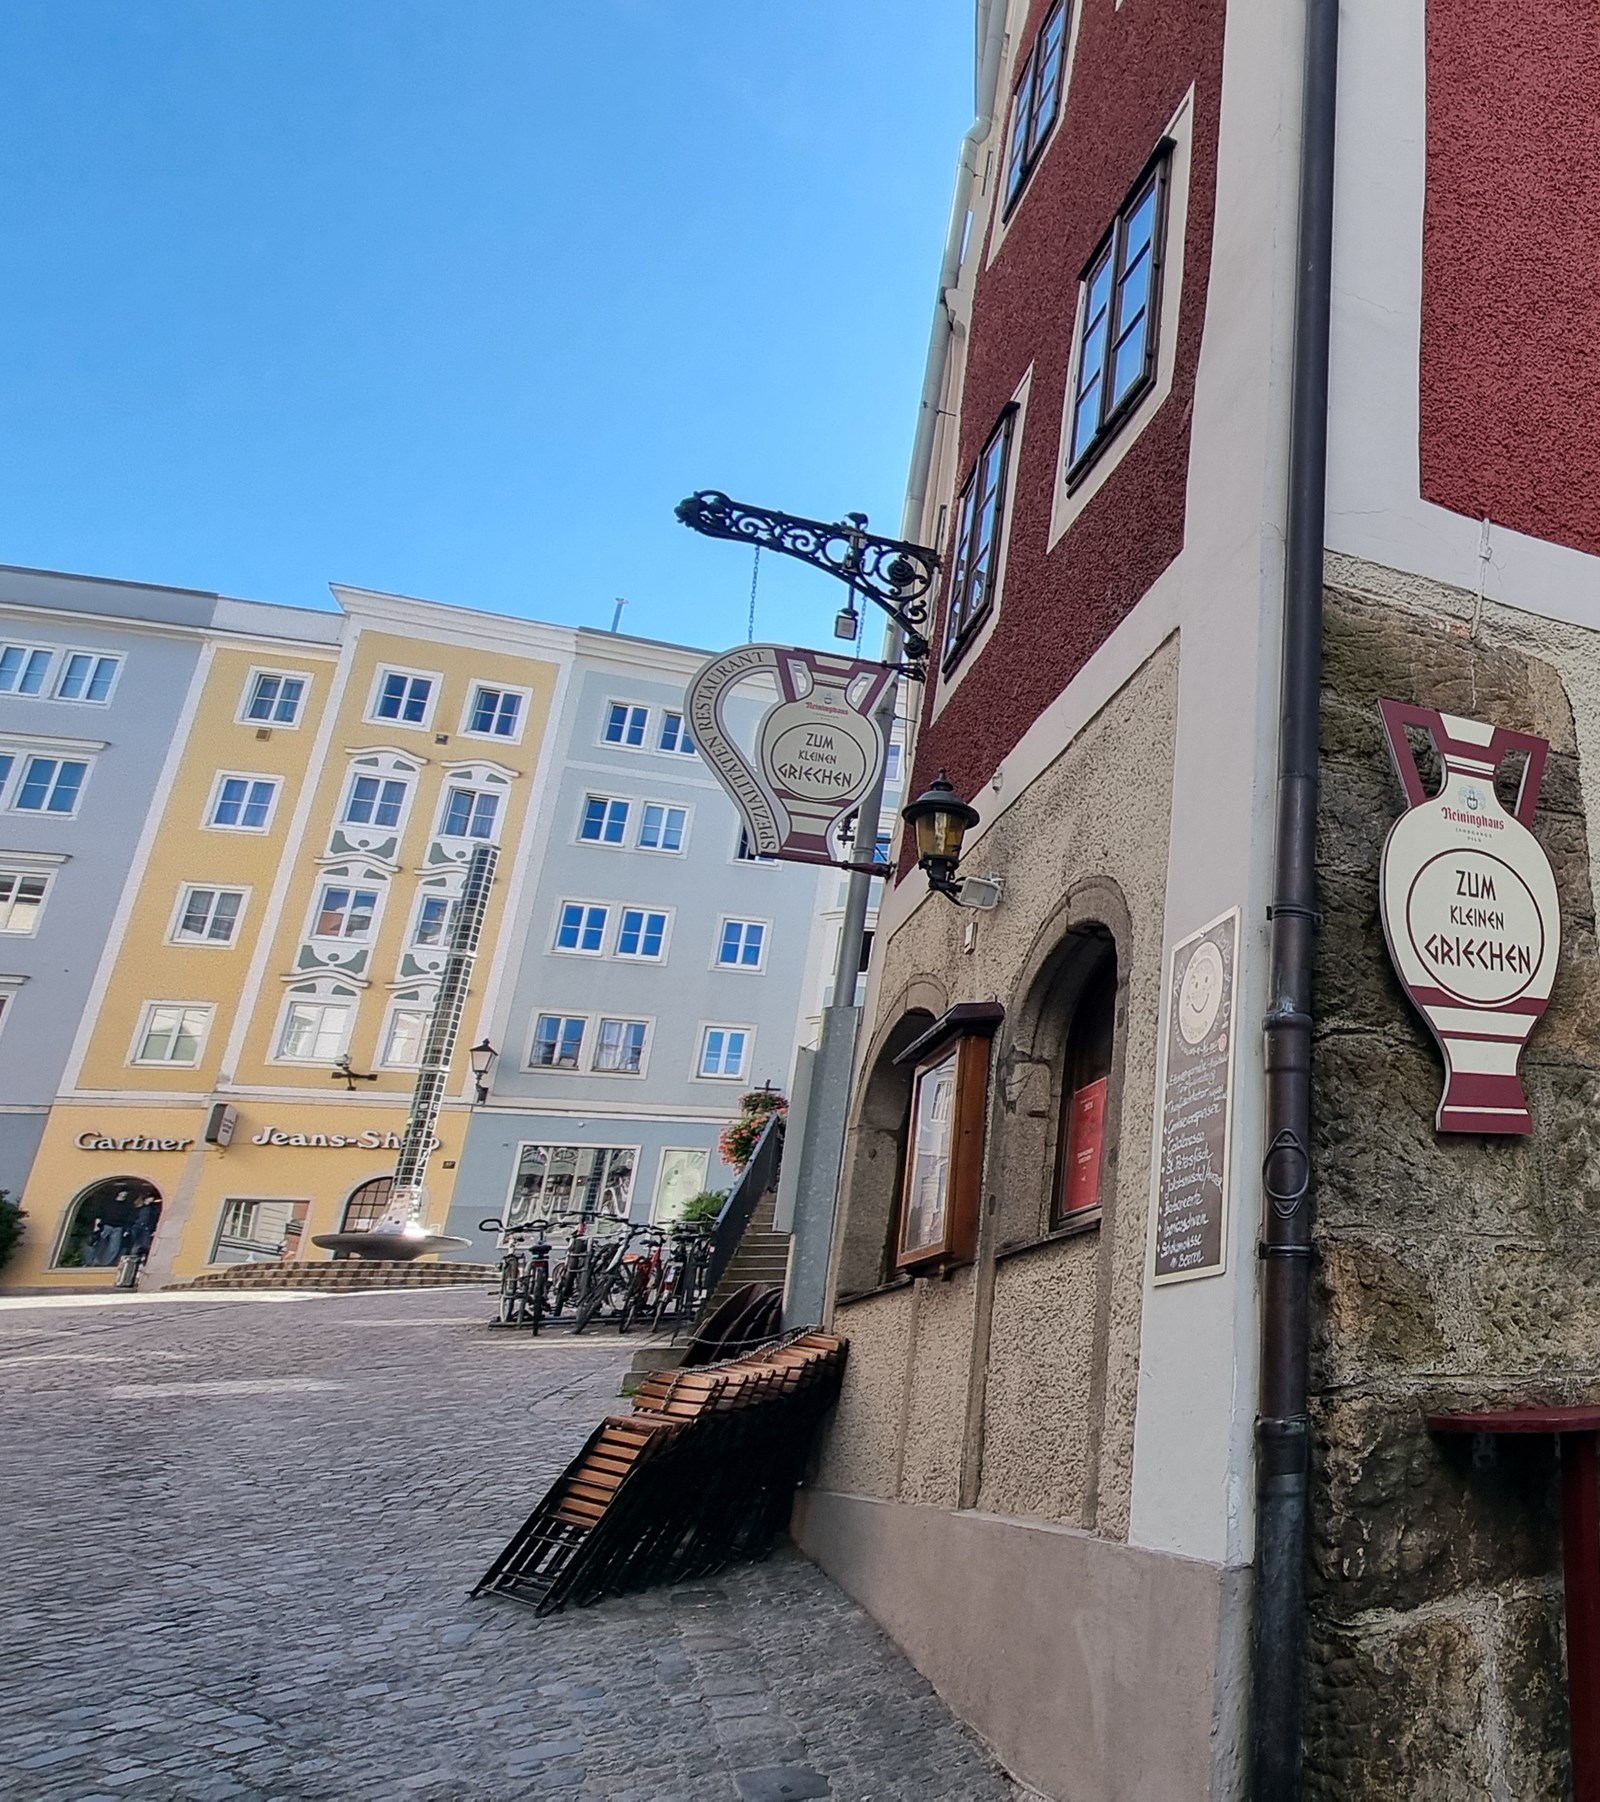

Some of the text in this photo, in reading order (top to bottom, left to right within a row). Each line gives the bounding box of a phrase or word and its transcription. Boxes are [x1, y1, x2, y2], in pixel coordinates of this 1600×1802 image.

[695, 651, 765, 732] RESTAURANT
[805, 732, 834, 750] ZUM
[798, 749, 837, 765] KLEINEN
[778, 763, 852, 788] GRIECHEN
[1441, 806, 1505, 830] Reininghaus
[1455, 869, 1496, 901] ZUM
[1450, 905, 1504, 931] KLEINEN
[1424, 933, 1531, 975] GRIECHEN
[74, 1131, 194, 1151] Gartner
[252, 1126, 441, 1151] Jeans-Shp
